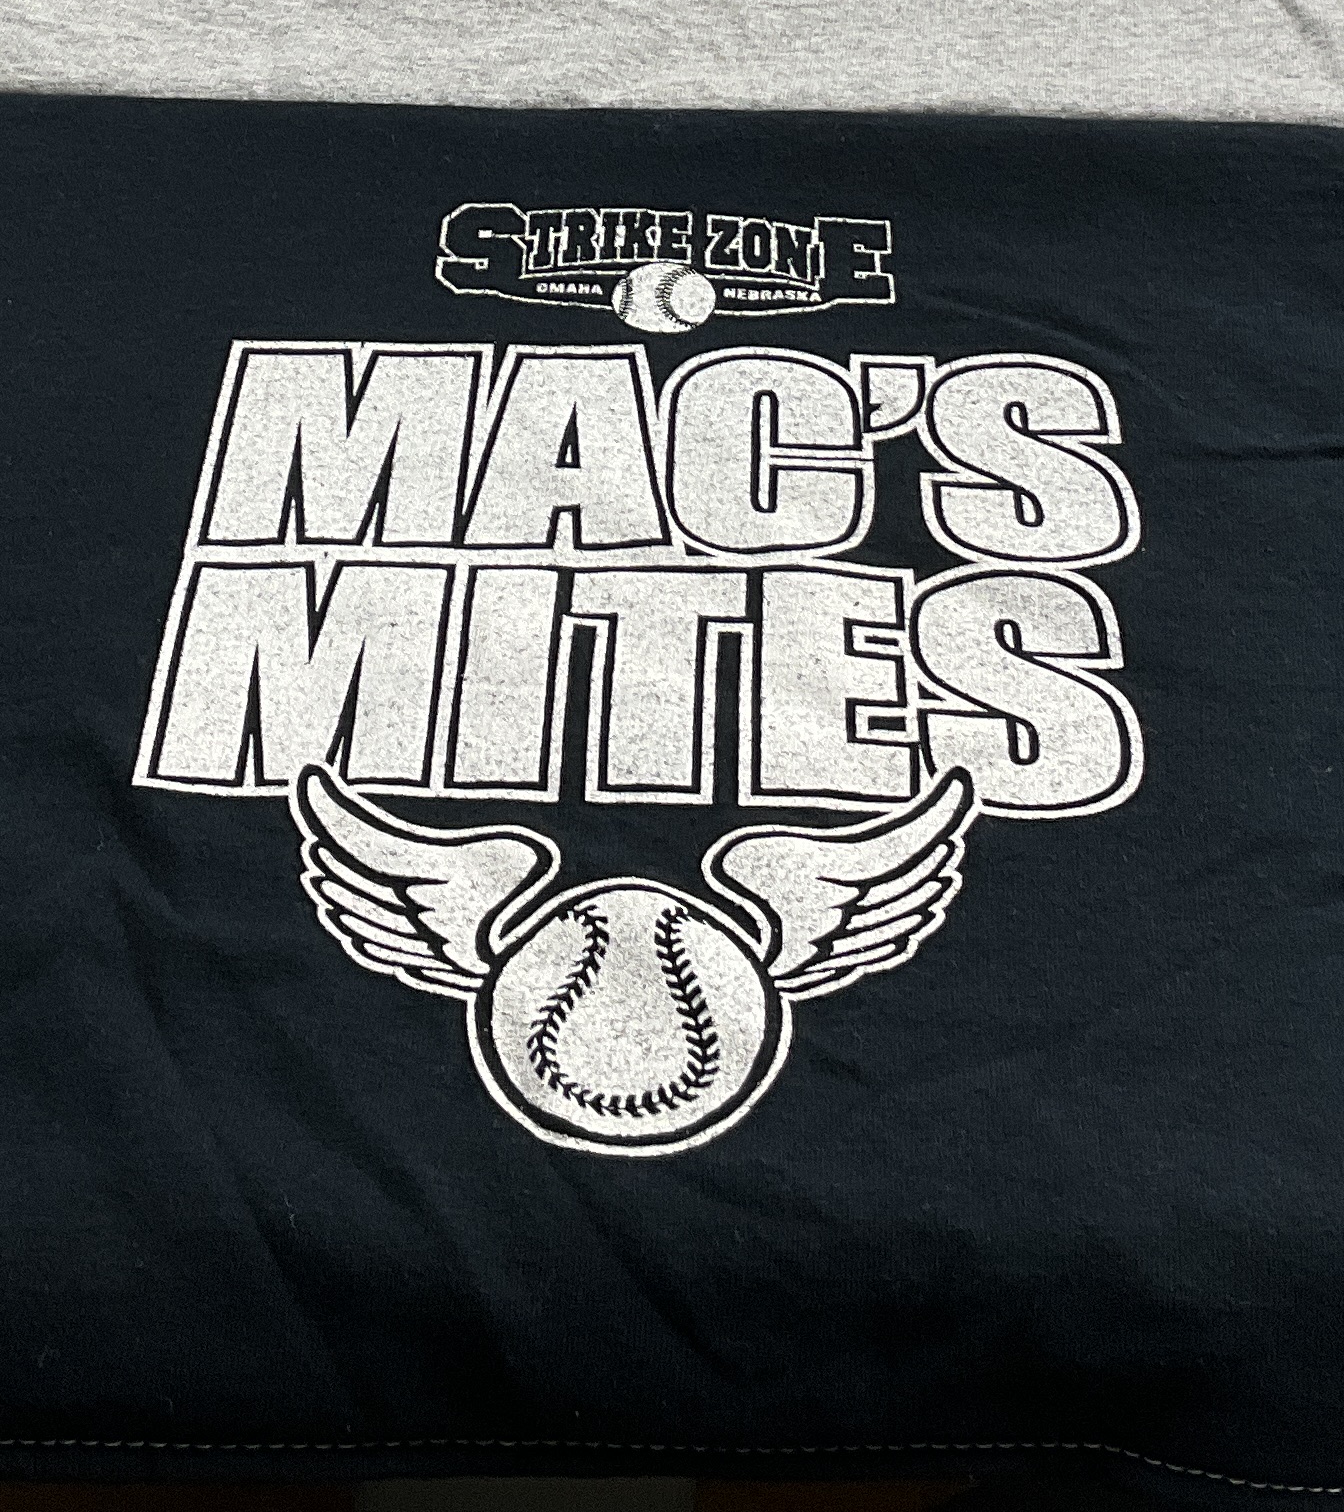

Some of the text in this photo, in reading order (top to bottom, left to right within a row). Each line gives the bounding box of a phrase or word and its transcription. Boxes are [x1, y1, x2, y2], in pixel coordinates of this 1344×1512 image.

[435, 202, 896, 306] STRIKE ZONE
[535, 281, 823, 303] OMAHA NEBRASKA
[186, 339, 1143, 568] MAC'S
[131, 553, 1145, 820] MITES
